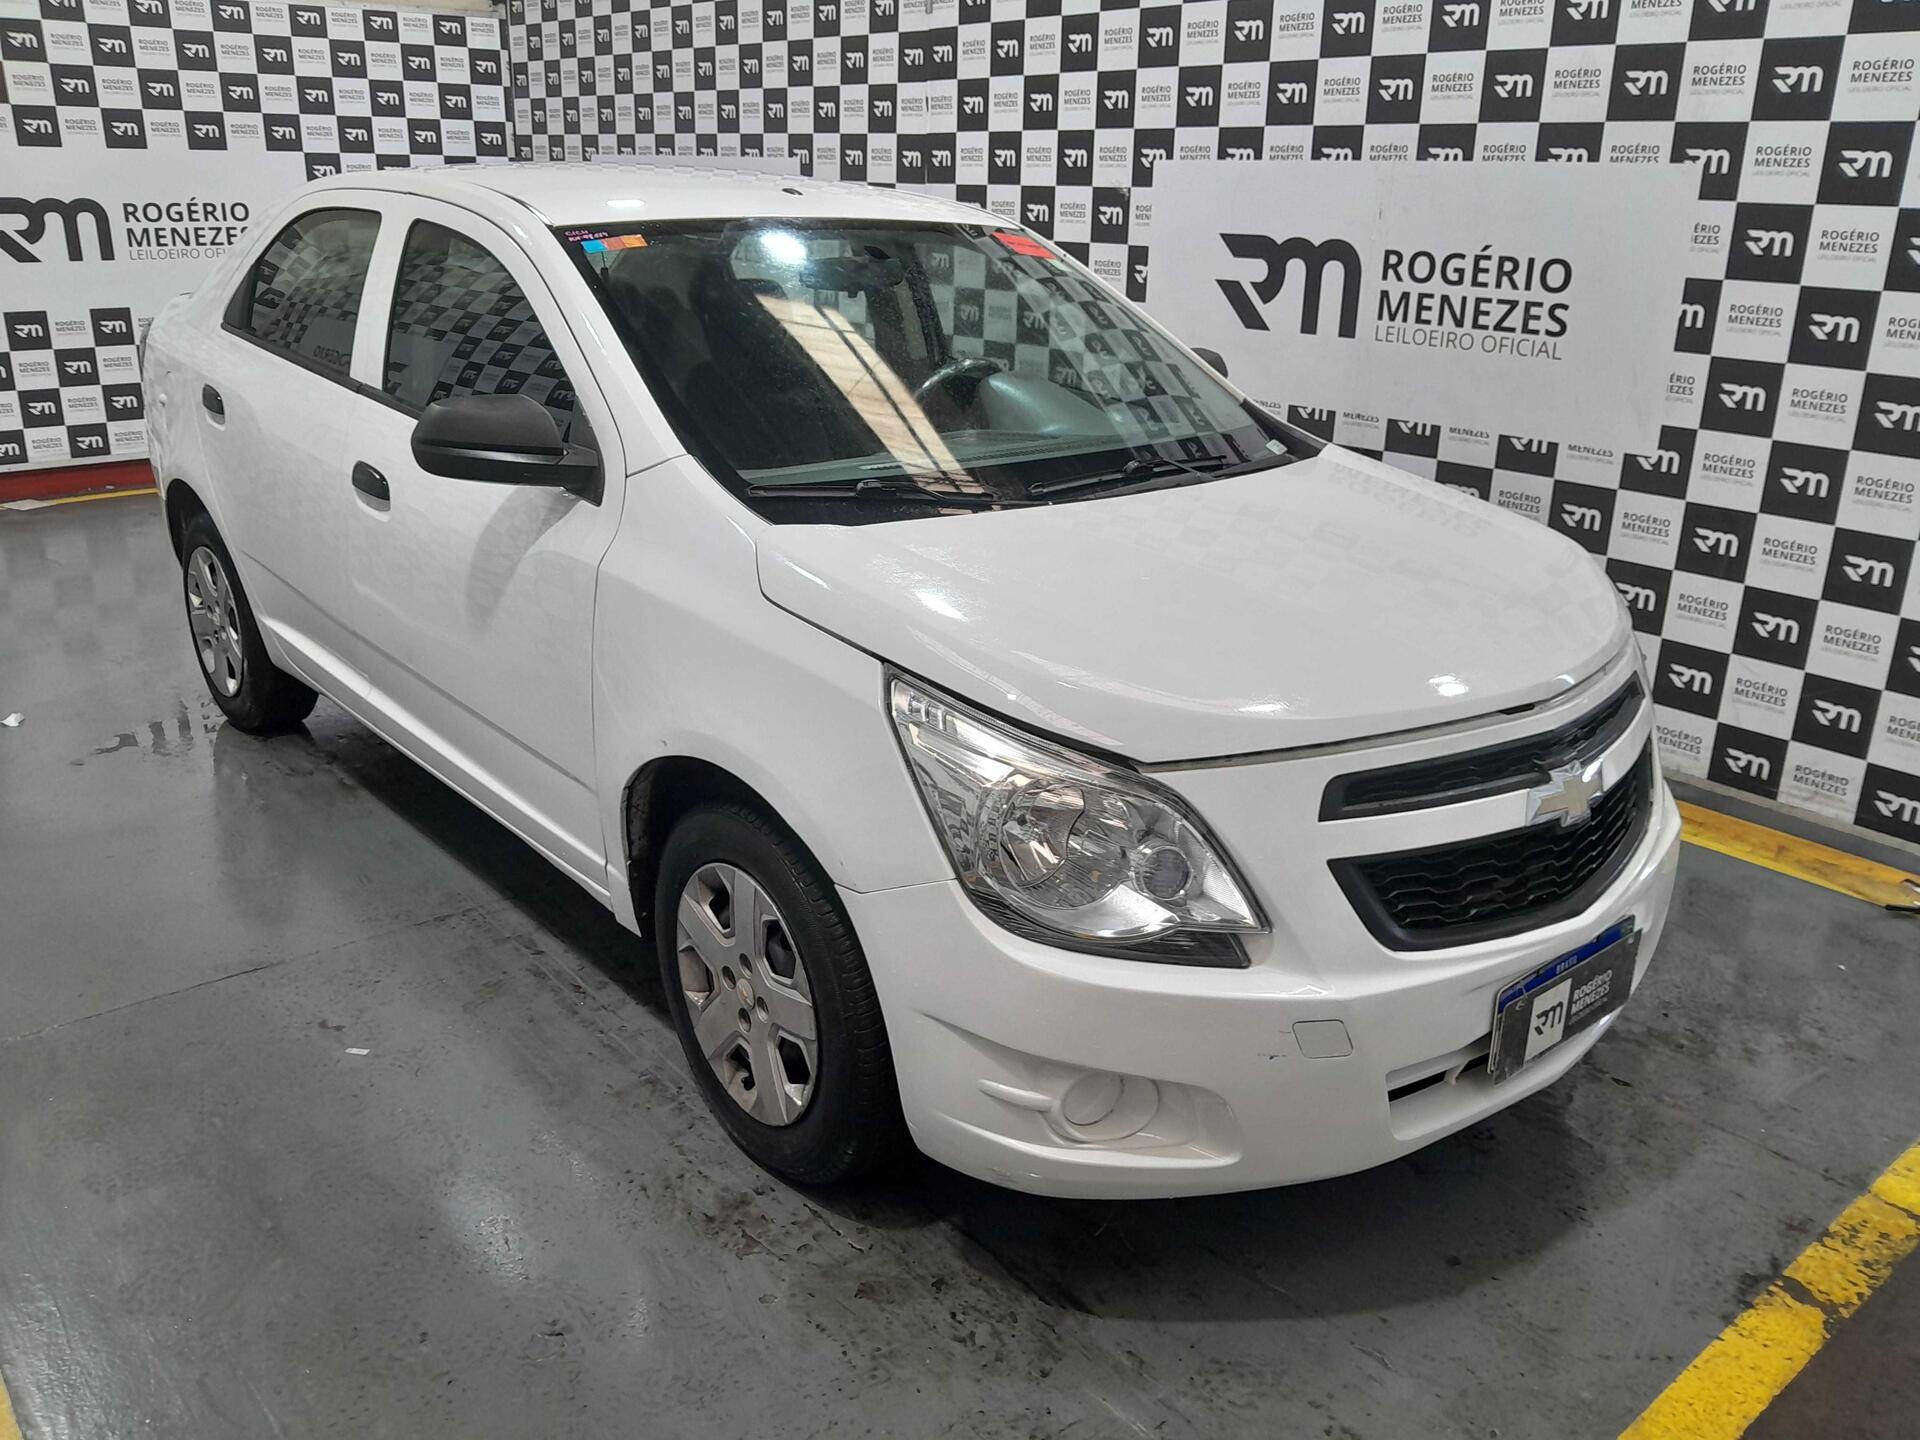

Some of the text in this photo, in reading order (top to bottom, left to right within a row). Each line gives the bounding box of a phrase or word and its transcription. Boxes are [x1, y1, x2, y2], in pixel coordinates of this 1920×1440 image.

[1384, 2, 1422, 14] ROGÉRIO
[1631, 0, 1681, 8] MENEZES
[1280, 11, 1315, 23] ROGÉRIO
[1500, 6, 1543, 16] MENEZES
[1188, 19, 1219, 30] ROGÉRIO
[1383, 14, 1421, 24] MENEZES
[1105, 26, 1133, 36] ROGÉRIO
[1280, 21, 1314, 32] MENEZES
[1187, 29, 1219, 38] MENEZES
[1105, 35, 1133, 45] MENEZES
[1693, 63, 1746, 75] ROGÉRIO
[1853, 57, 1914, 70] ROGÉRIO
[1433, 71, 1473, 82] ROGÉRIO
[1555, 66, 1601, 78] ROGÉRIO
[1851, 71, 1912, 82] MENEZES
[1228, 80, 1261, 90] ROGÉRIO
[1325, 75, 1361, 87] ROGÉRIO
[1554, 80, 1600, 89] MENEZES
[1692, 76, 1744, 86] MENEZES
[1142, 84, 1172, 94] ROGÉRIO
[1324, 86, 1361, 96] MENEZES
[1432, 83, 1472, 92] MENEZES
[1142, 94, 1171, 102] MENEZES
[1228, 90, 1261, 99] MENEZES
[1370, 142, 1408, 153] ROGÉRIO
[1483, 142, 1526, 153] ROGÉRIO
[1611, 142, 1660, 154] ROGÉRIO
[1756, 144, 1811, 156] ROGÉRIO
[1755, 158, 1810, 167] MENEZES
[122, 197, 250, 223] ROGÉRIO
[1694, 223, 1720, 234] ÉRIO
[126, 226, 248, 248] MENEZE
[1694, 235, 1719, 245] EZES
[1821, 228, 1879, 242] ROGÉRIO
[1819, 242, 1877, 253] MENEZES
[129, 248, 200, 261] LEILOEIRO
[1381, 245, 1573, 294] ROGÉRIO
[1377, 289, 1570, 338] MENEZES
[1730, 304, 1783, 317] ROGÉRIO
[1728, 315, 1781, 328] MENEZES
[1375, 325, 1563, 361] LEILOEIRO OFICIAL
[1670, 373, 1695, 385] ÉRIO
[1669, 385, 1694, 395] EZES
[1792, 388, 1848, 403] ROGÉRIO
[1791, 399, 1846, 414] MENEZES
[1704, 453, 1755, 468] ROGÉRIO
[1703, 463, 1753, 479] MENEZES
[1857, 476, 1914, 492] ROGÉRIO
[1498, 490, 1541, 504] ROGÉRIO
[1855, 487, 1912, 503] MENEZES
[1497, 498, 1540, 514] MENEZES
[1623, 512, 1670, 527] ROGÉRIO
[1622, 522, 1669, 537] MENEZES
[1764, 537, 1817, 555] ROGÉRIO
[1762, 548, 1815, 565] MENEZES
[1679, 593, 1728, 611] ROGÉRIO
[1677, 603, 1726, 620] MENEZES
[1826, 625, 1881, 644] ROGÉRIO
[1824, 635, 1879, 654] MENEZES
[1737, 678, 1787, 697] ROGÉRIO
[1734, 687, 1785, 706] MENEZES
[1795, 765, 1849, 786] ROGÉRIO
[1793, 774, 1846, 796] MENEZES
[1573, 969, 1613, 1002] ROGÉRIO
[1571, 982, 1611, 1016] MENEZES
